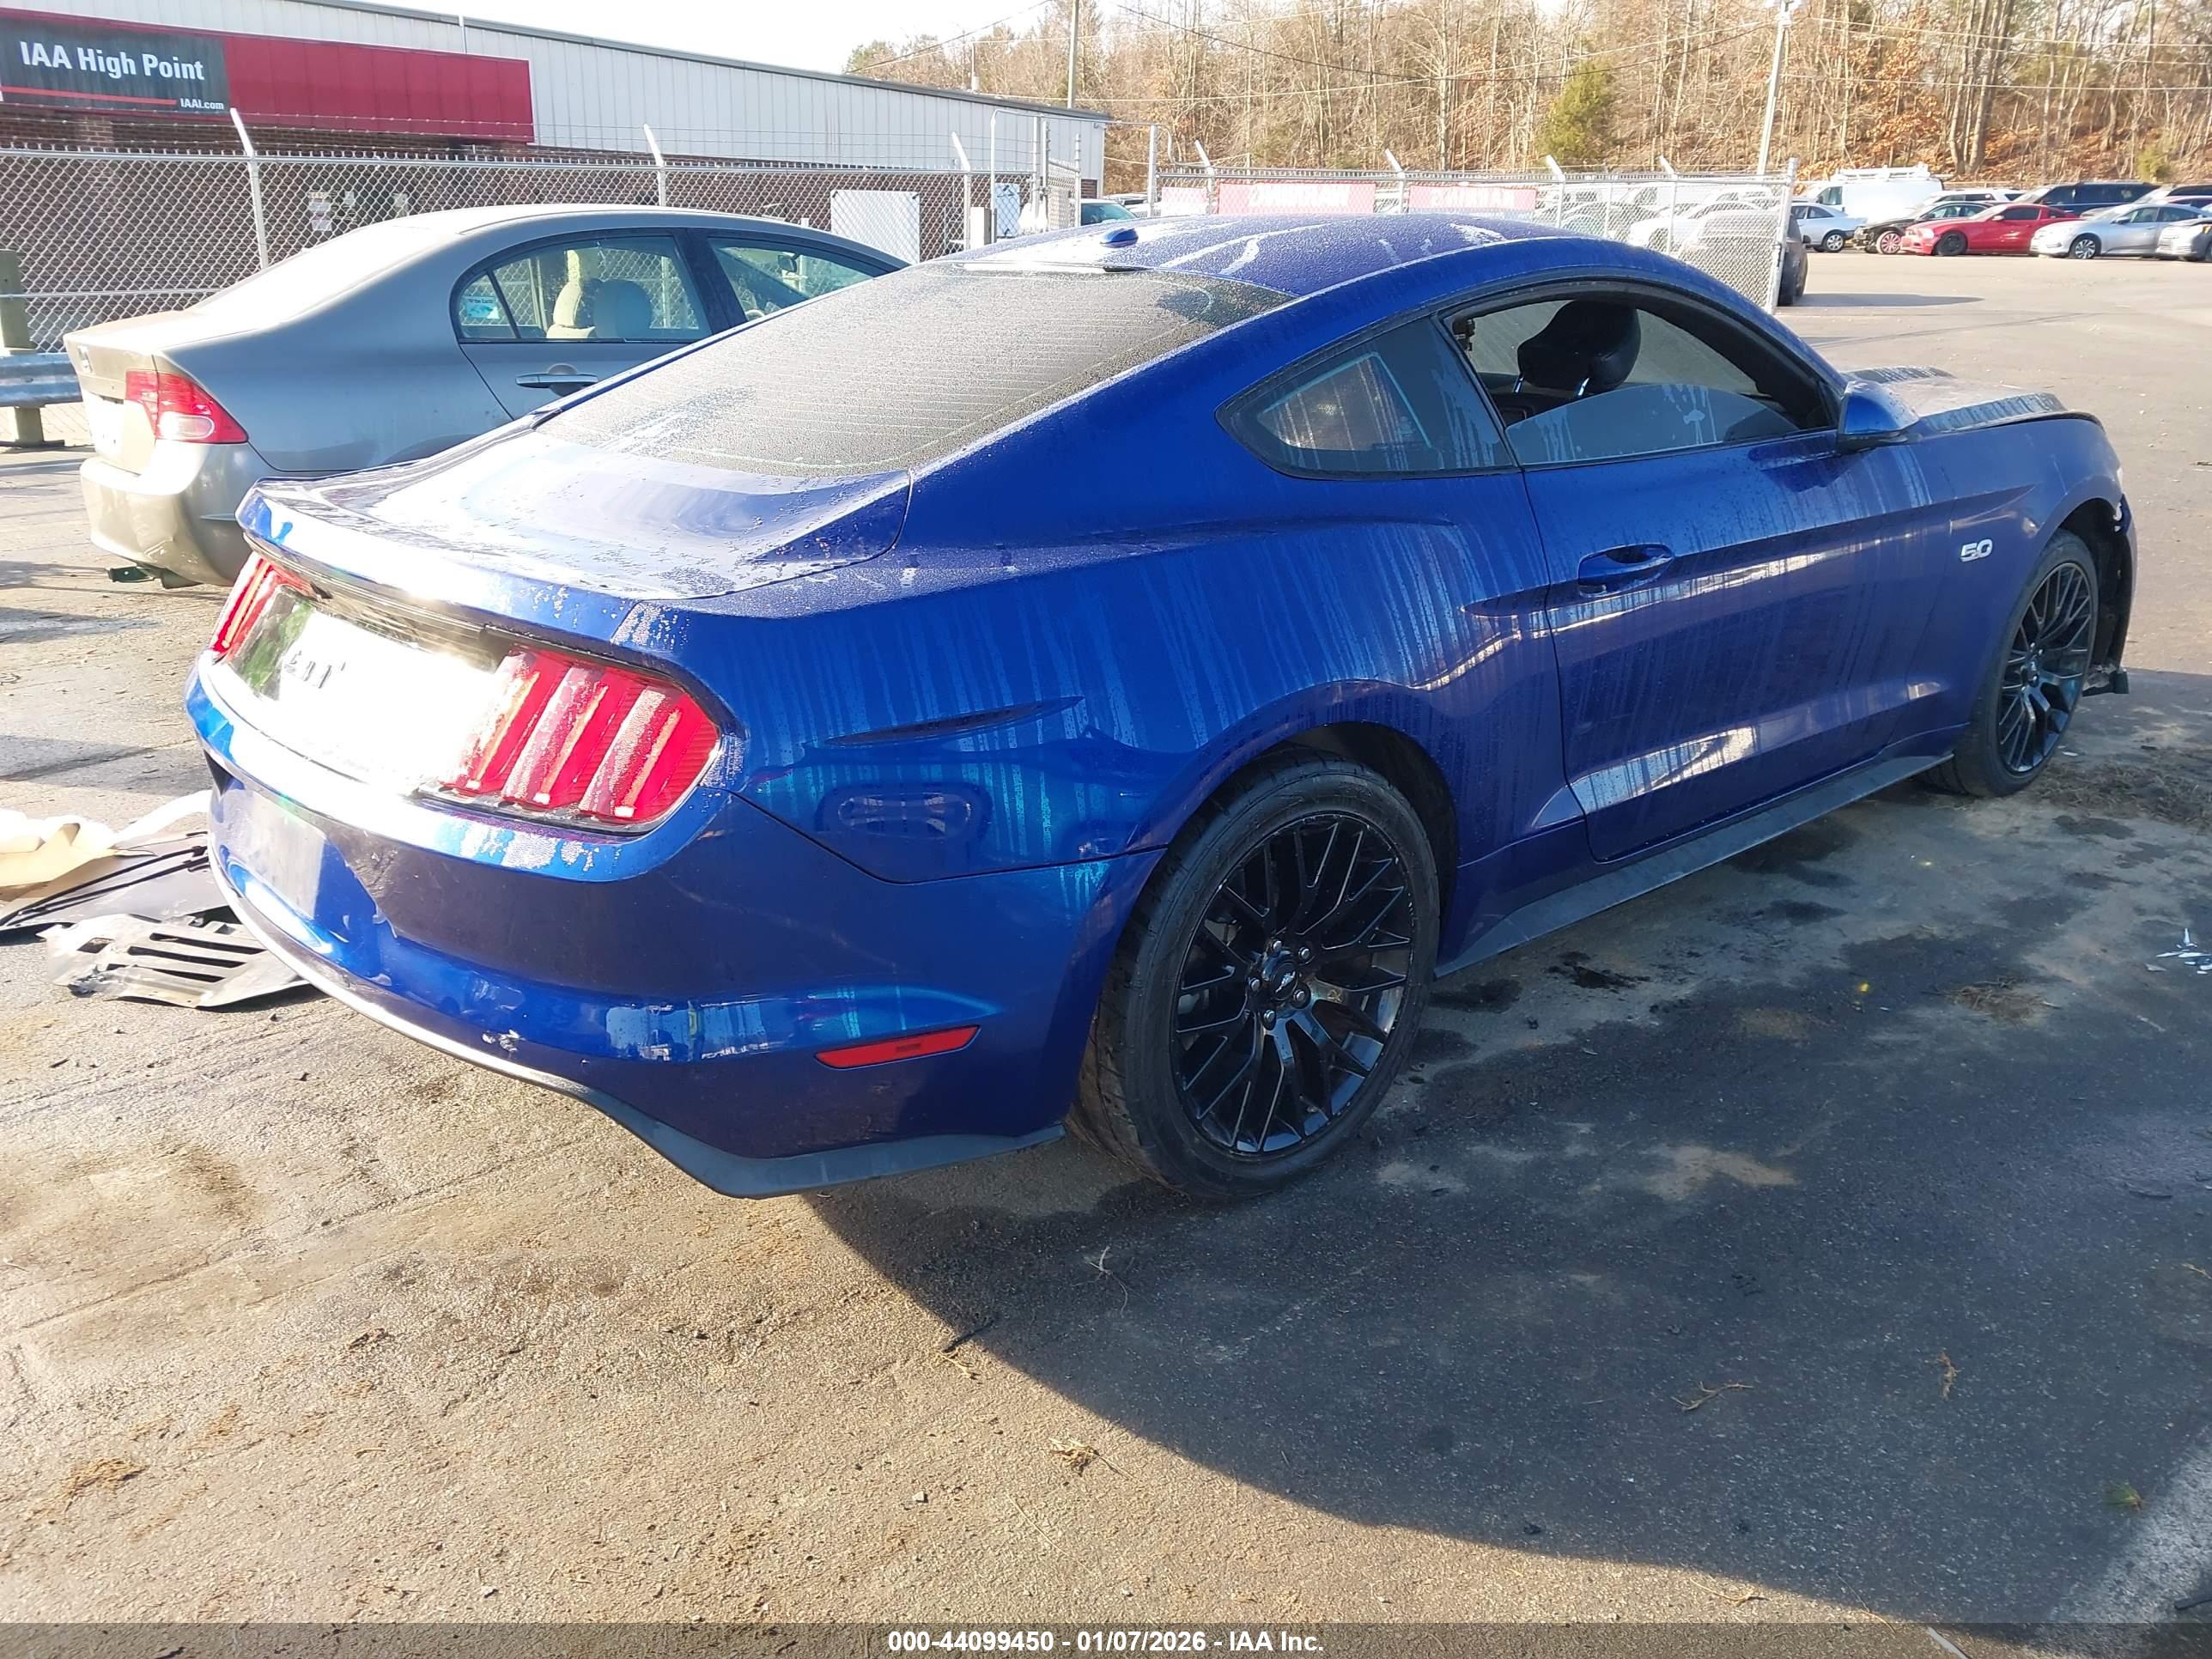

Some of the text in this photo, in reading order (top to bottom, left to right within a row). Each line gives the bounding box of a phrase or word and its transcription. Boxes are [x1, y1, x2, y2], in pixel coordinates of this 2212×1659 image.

[20, 41, 205, 81] IAA High Point
[179, 97, 225, 111] IAAI.com
